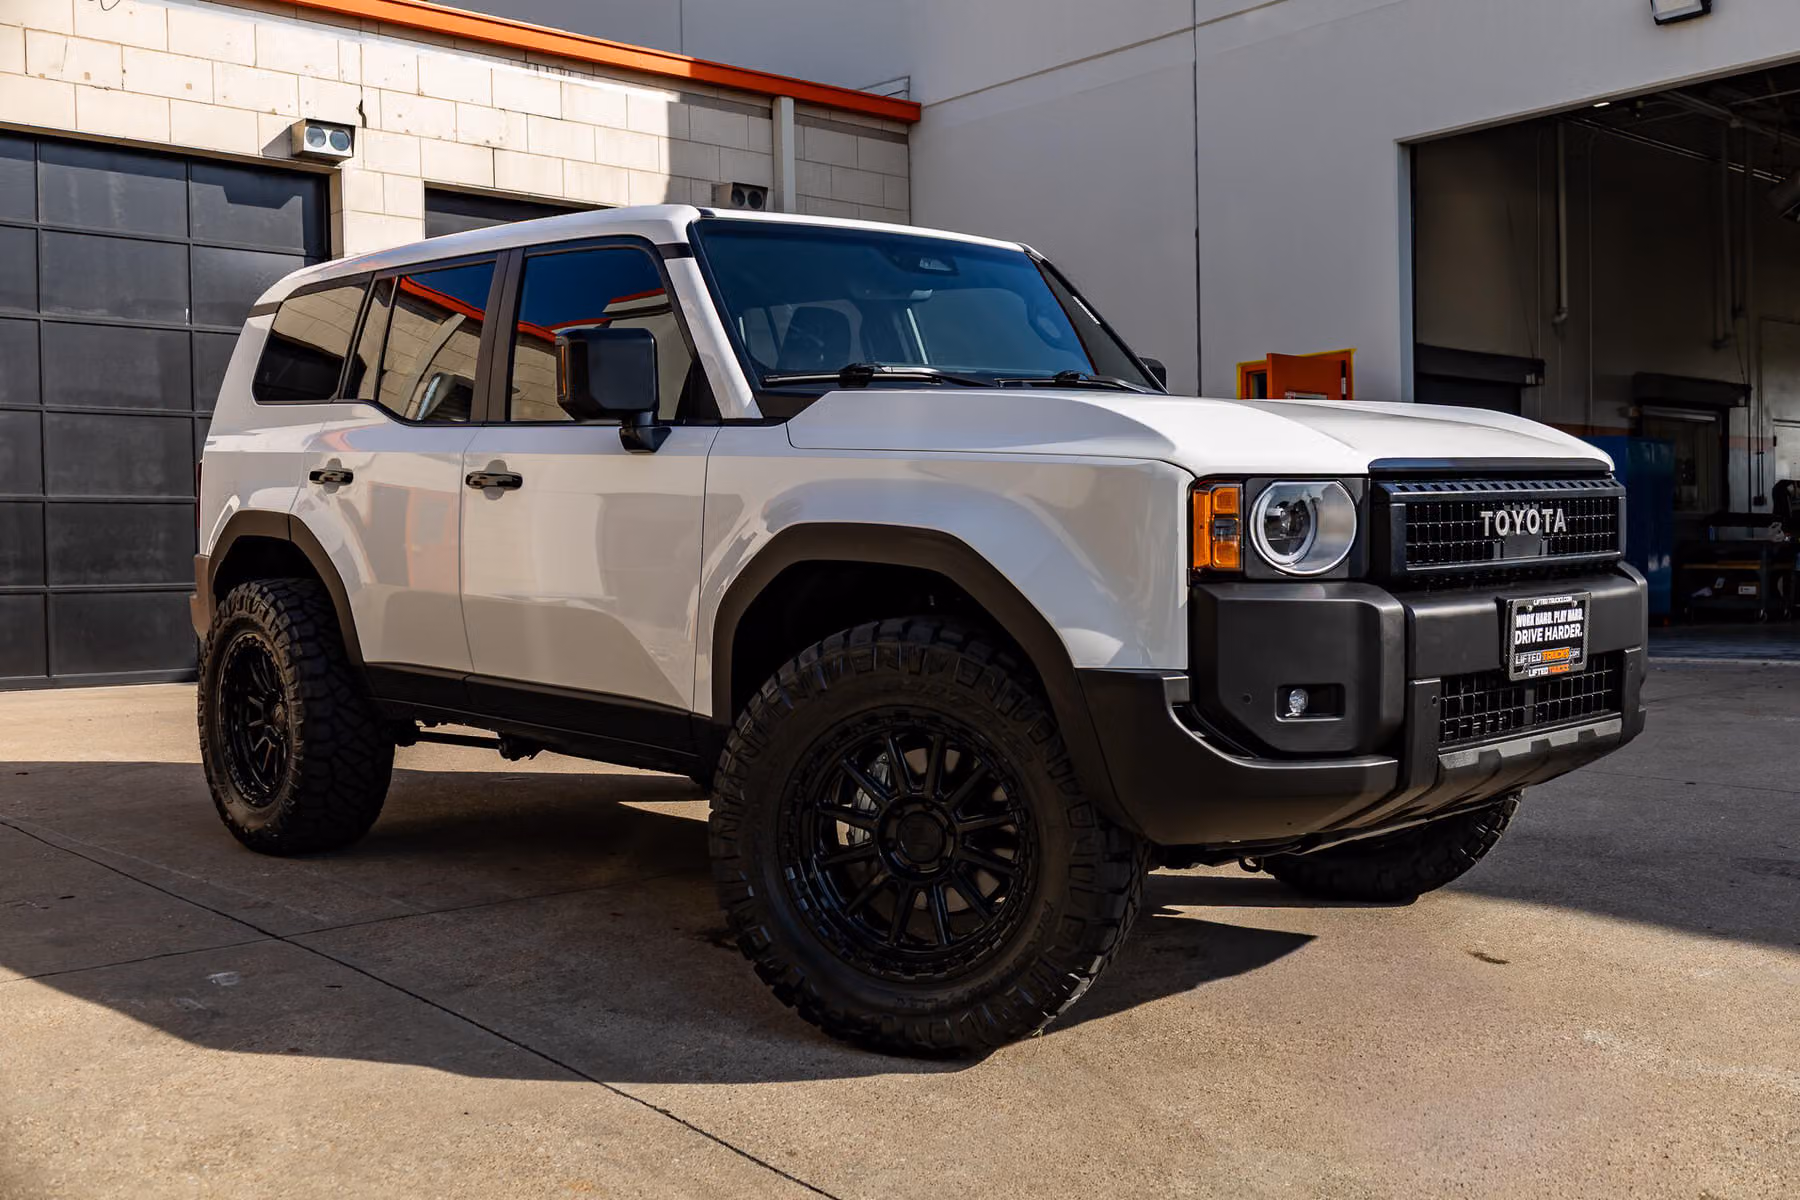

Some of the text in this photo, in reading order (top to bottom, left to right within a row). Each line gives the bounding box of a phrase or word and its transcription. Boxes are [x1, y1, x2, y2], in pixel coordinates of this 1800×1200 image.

[1480, 508, 1567, 537] TOYOTA
[1516, 614, 1534, 627] WORK
[1554, 610, 1567, 623] PLAY
[1514, 623, 1583, 645] DRIVE HARDER.
[1515, 652, 1541, 664] LIFTED
[1528, 667, 1549, 677] LIFTED
